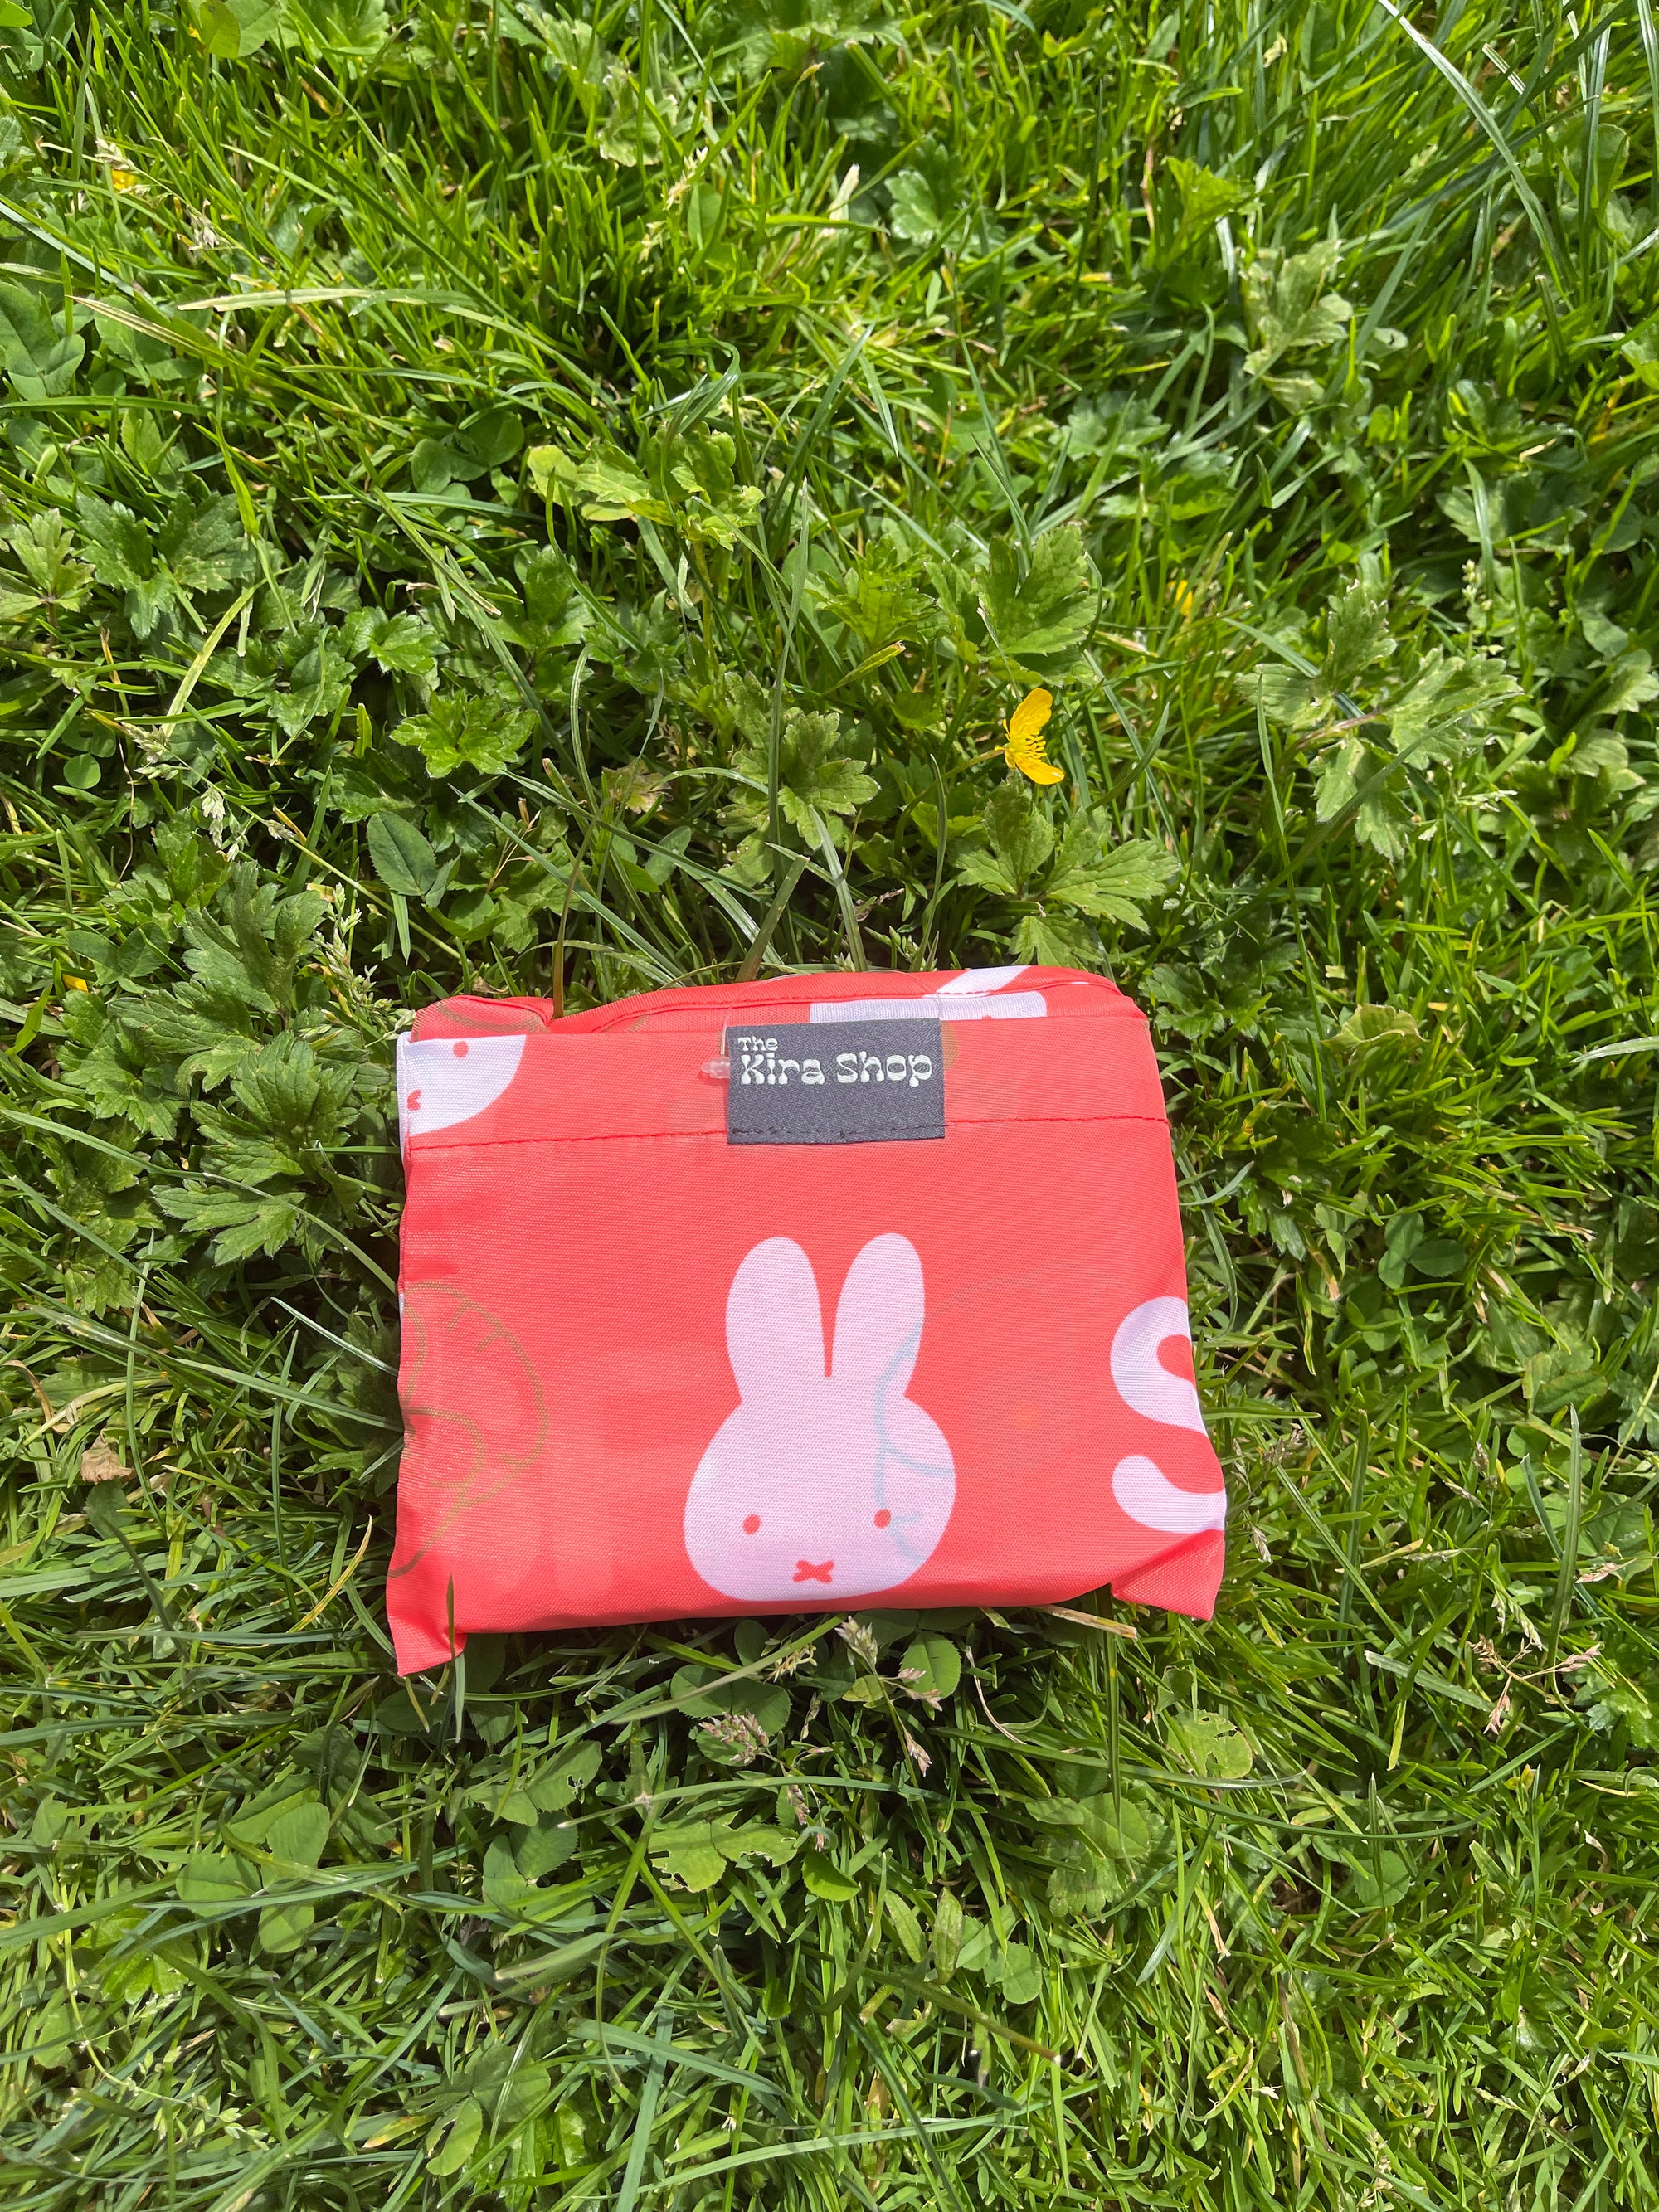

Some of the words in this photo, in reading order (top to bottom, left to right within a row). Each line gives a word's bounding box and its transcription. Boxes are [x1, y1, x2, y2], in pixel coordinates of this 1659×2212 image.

[737, 1036, 778, 1052] The
[740, 1053, 825, 1085] Kira
[836, 1050, 932, 1087] Shop
